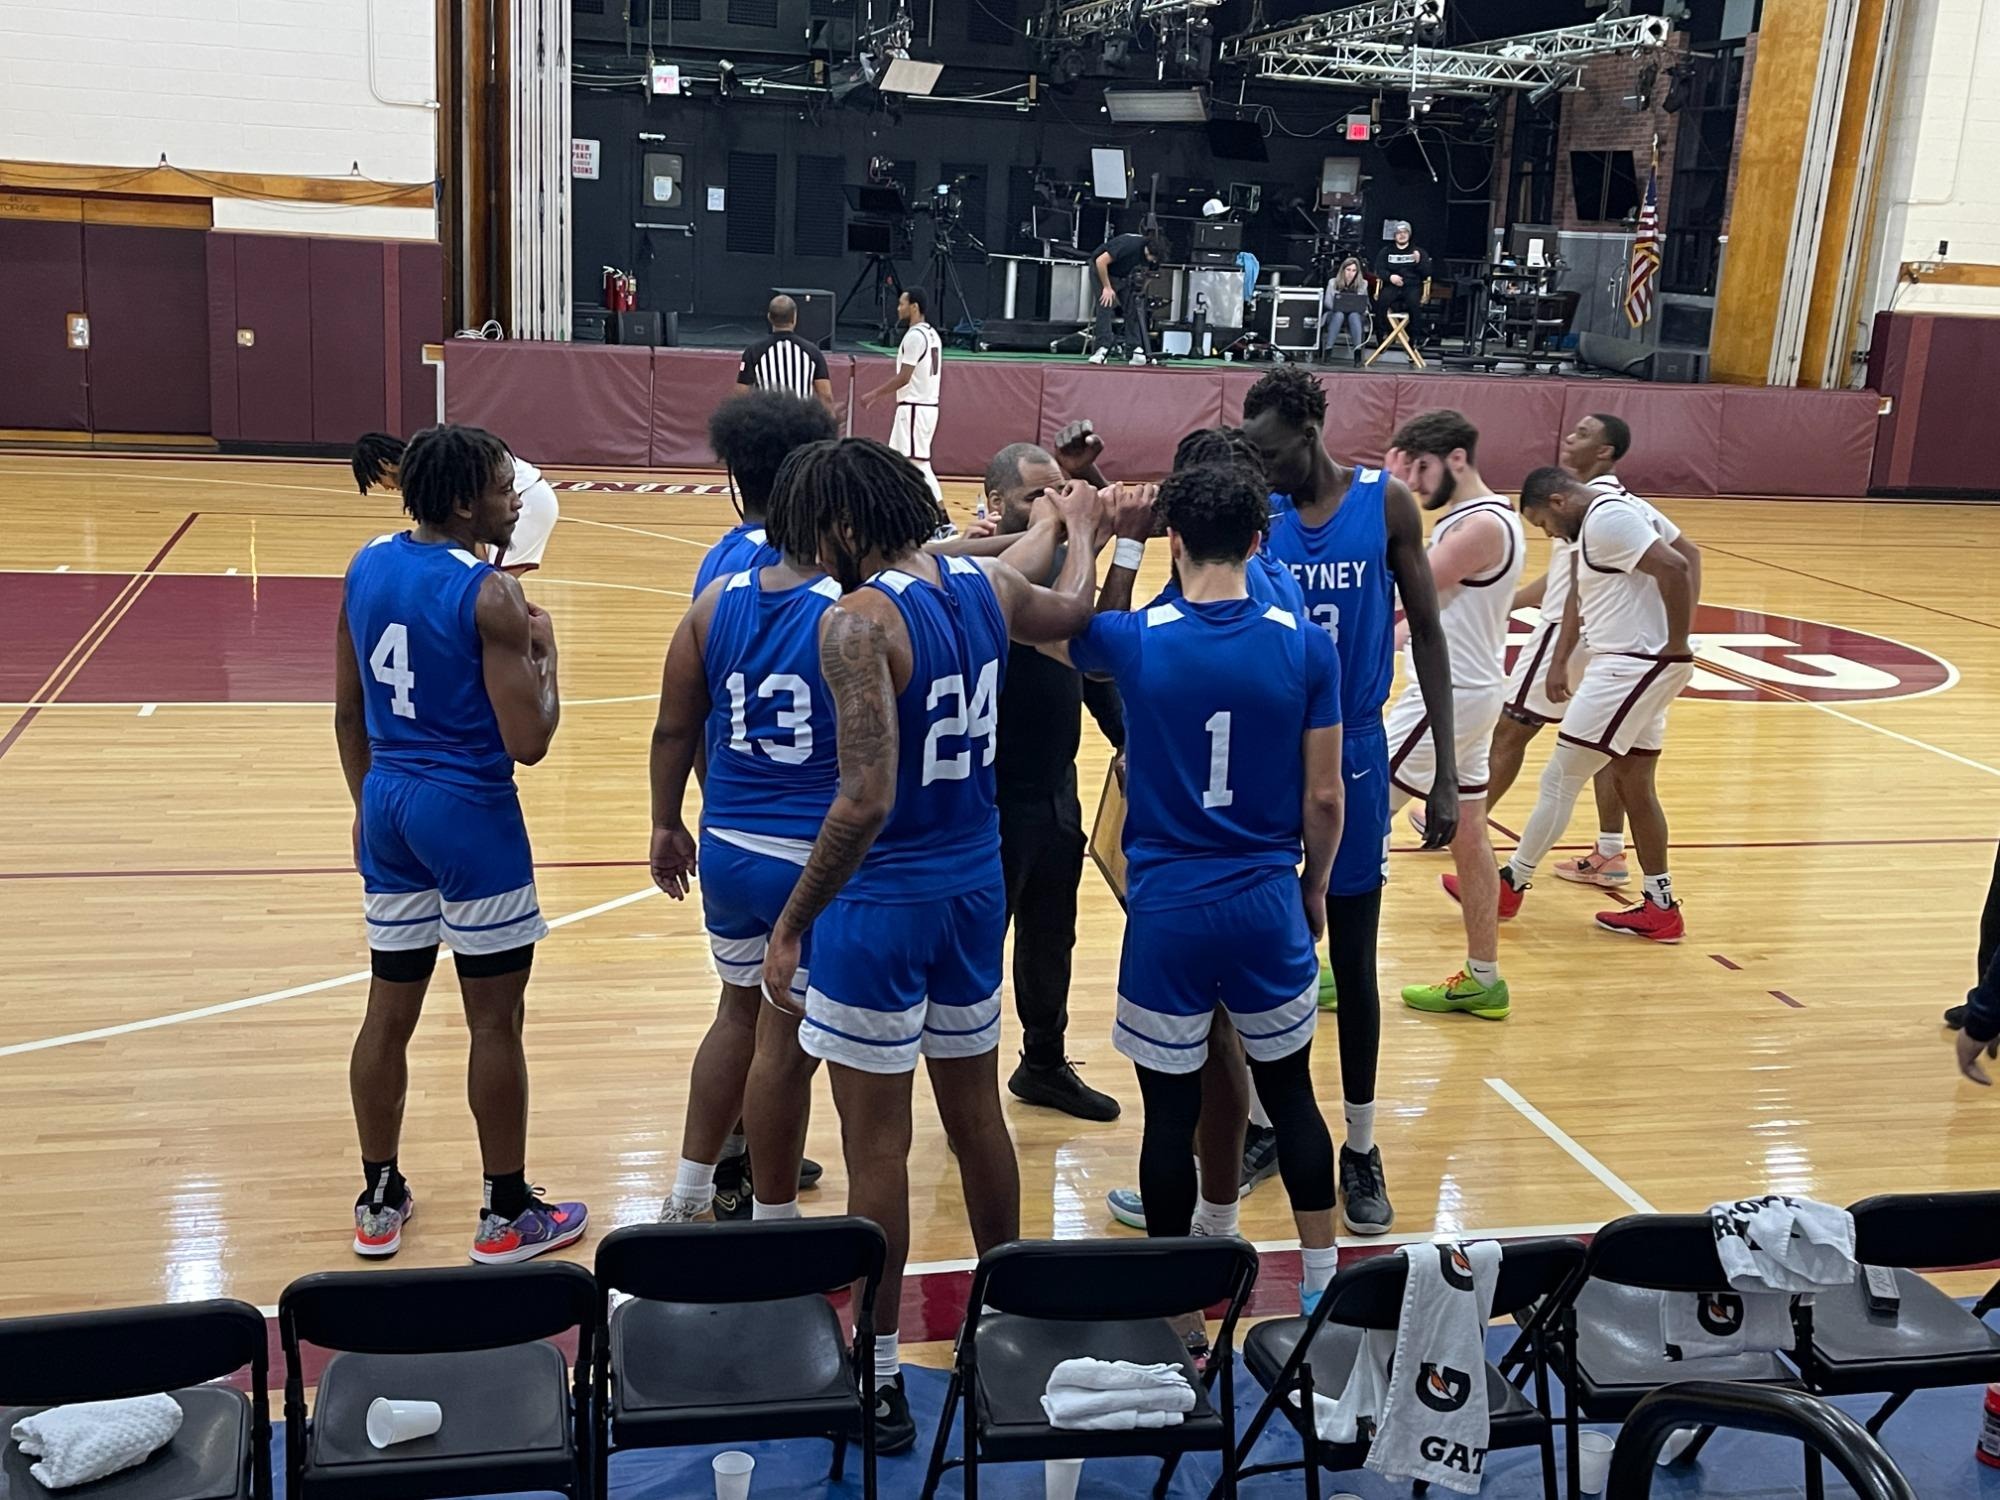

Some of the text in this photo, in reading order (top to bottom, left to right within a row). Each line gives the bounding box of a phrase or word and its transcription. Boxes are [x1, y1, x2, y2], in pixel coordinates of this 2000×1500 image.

[1286, 560, 1367, 590] EYNEY
[369, 622, 416, 719] 4
[1304, 603, 1340, 644] 3
[725, 671, 813, 765] 13
[921, 658, 999, 787] 24
[1202, 711, 1233, 809] 1
[1419, 1435, 1487, 1475] GAT
